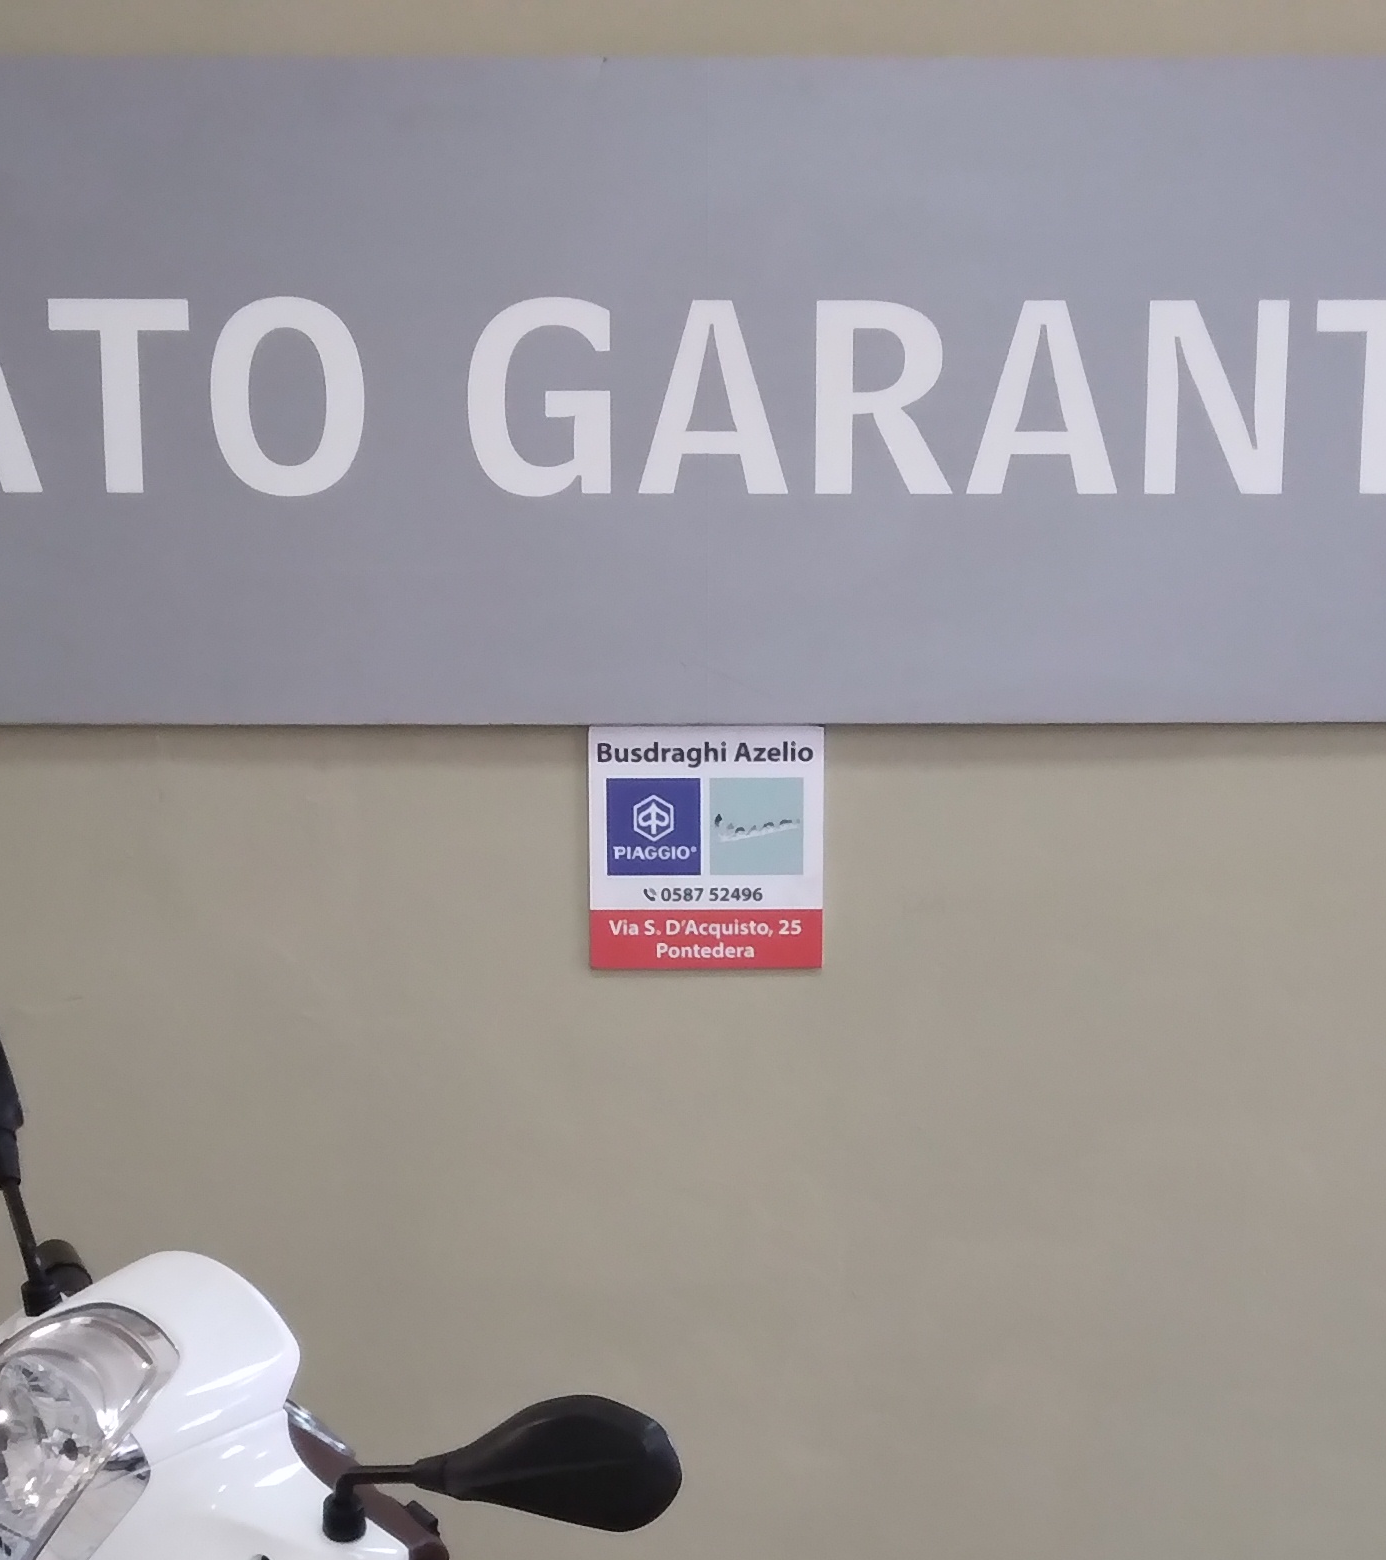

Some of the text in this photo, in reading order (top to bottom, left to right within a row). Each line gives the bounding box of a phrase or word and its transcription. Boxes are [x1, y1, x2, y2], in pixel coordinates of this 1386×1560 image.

[597, 741, 814, 768] Busdraghi Azelio
[660, 887, 763, 902] 0587 52496
[609, 919, 802, 939] Via S. D'Acquisto, 25
[656, 942, 755, 959] Pontedera
